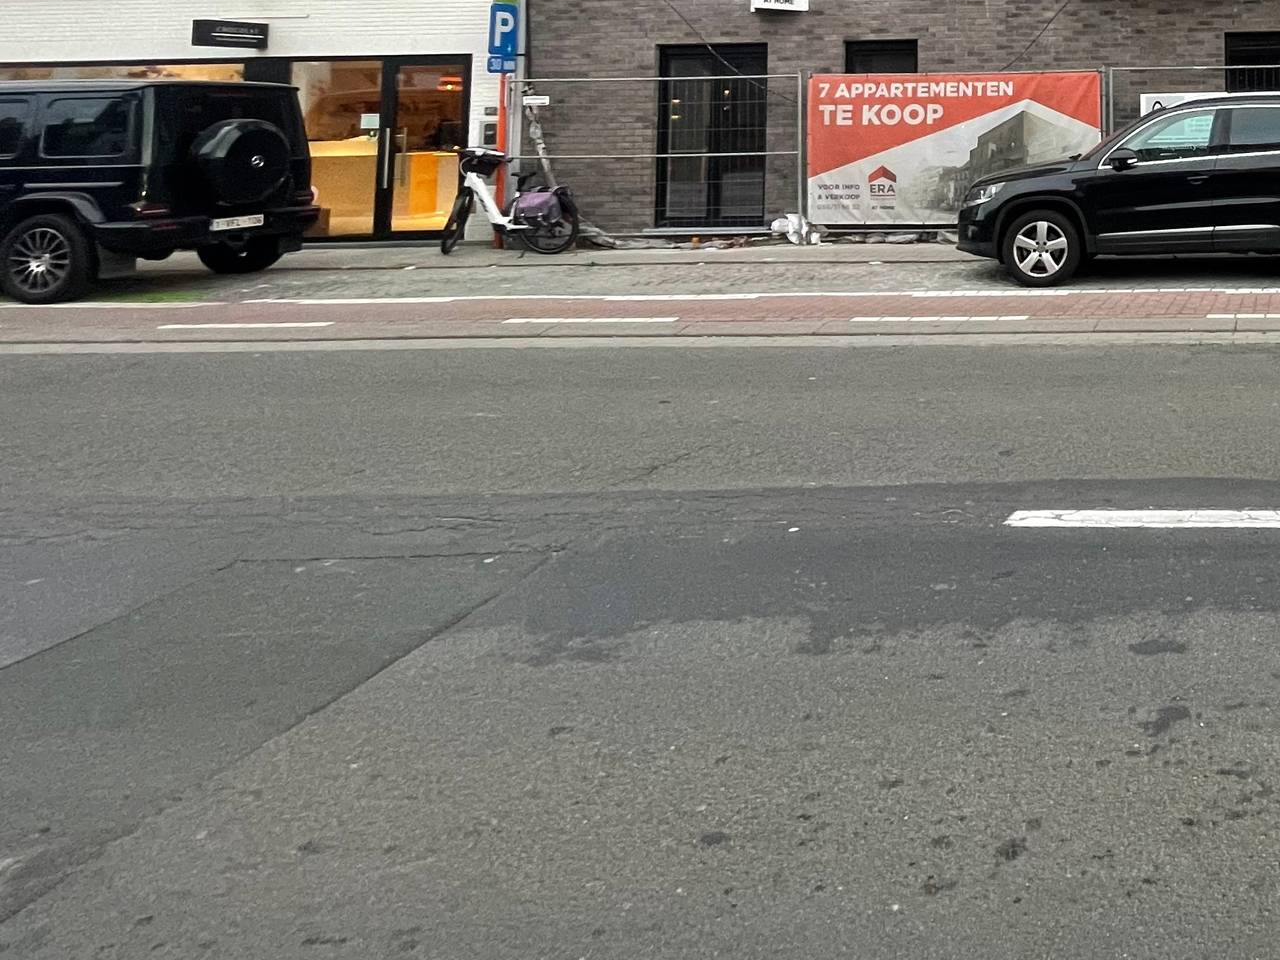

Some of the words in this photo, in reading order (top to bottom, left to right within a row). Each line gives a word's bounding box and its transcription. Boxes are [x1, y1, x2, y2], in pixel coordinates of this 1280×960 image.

[494, 11, 515, 47] P
[819, 83, 830, 98] 7
[834, 81, 1014, 98] APPARTEMENTEN
[819, 105, 853, 126] TE
[861, 103, 944, 126] KOOP
[869, 184, 896, 193] ERA
